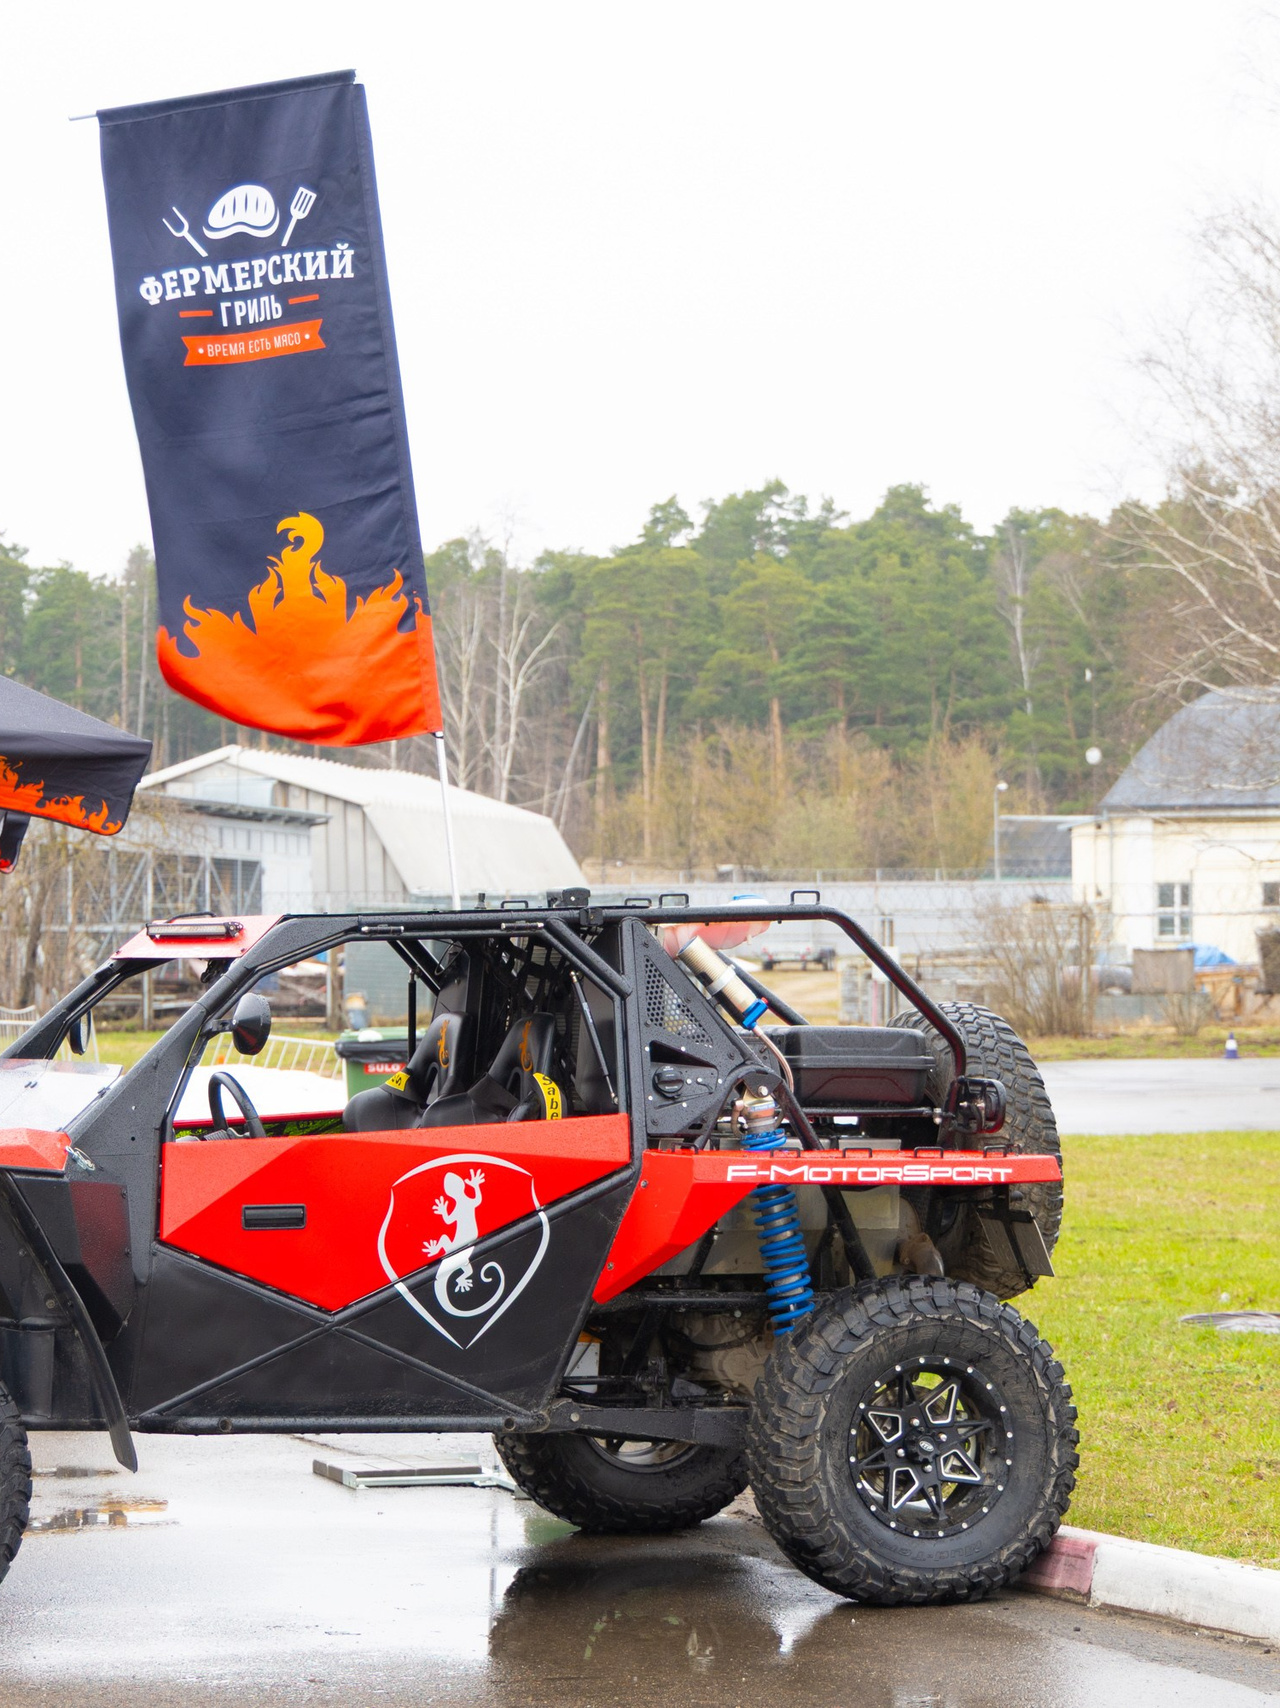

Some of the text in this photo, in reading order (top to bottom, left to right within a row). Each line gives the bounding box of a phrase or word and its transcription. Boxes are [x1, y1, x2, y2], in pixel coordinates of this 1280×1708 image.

[139, 243, 355, 305] ФЕРМЕРСКИЙ
[220, 294, 283, 327] ГРИЛЬ
[207, 332, 301, 357] ВРЕМЯ ЕСТЬ МЯСО
[367, 1063, 401, 1072] SULO
